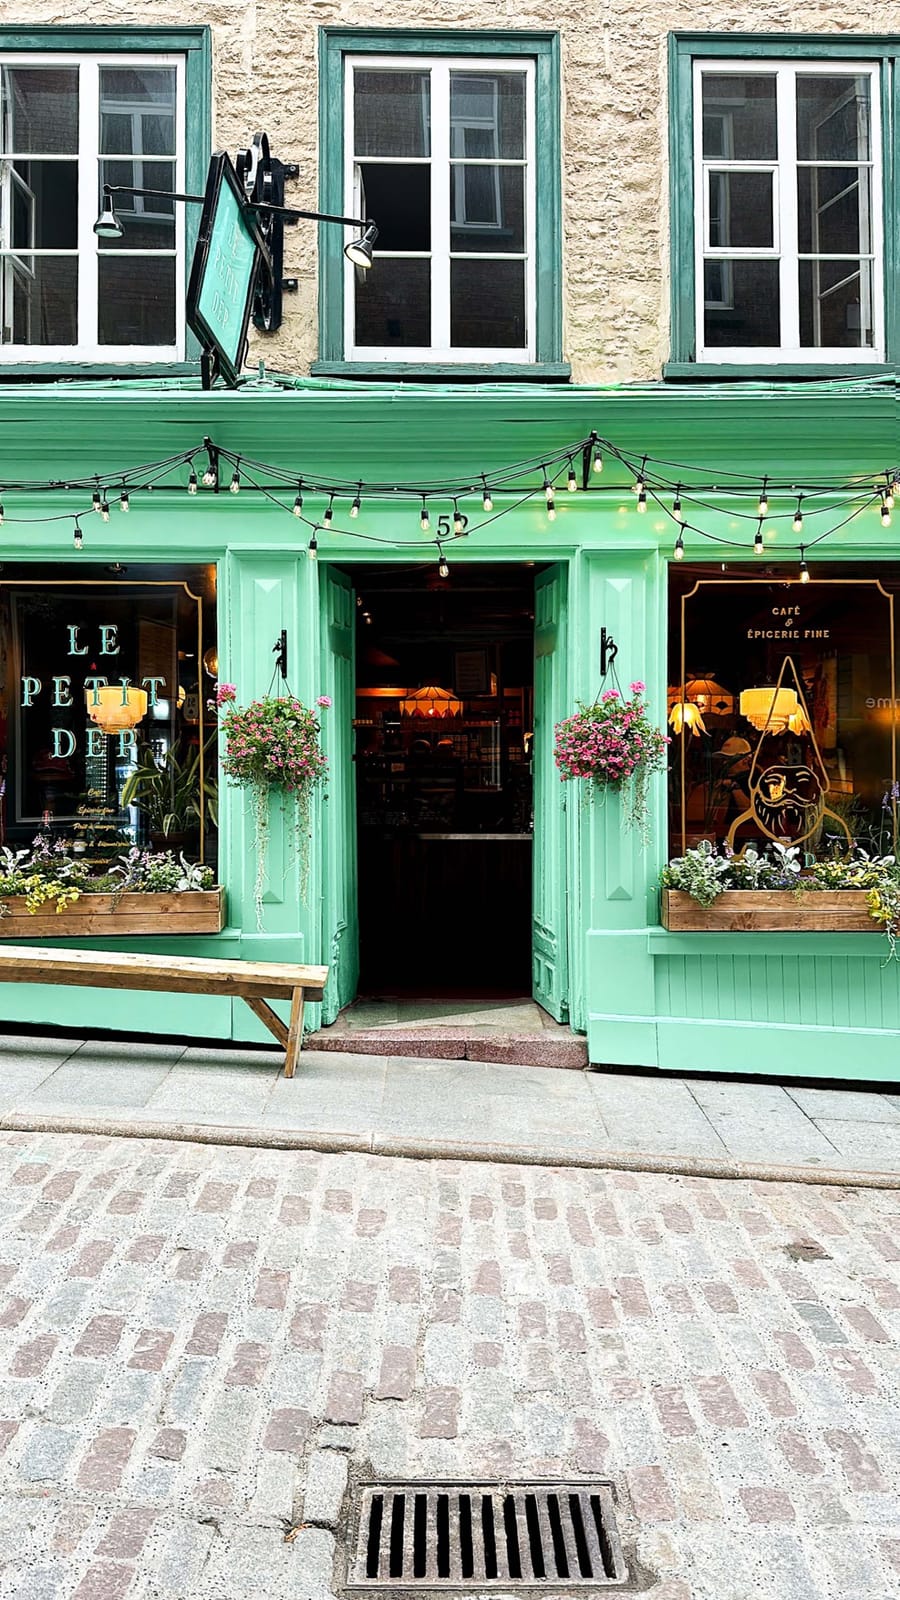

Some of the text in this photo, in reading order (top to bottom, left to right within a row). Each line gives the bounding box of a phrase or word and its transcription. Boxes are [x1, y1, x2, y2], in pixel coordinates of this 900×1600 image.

[772, 605, 800, 615] CAFÉ
[67, 624, 121, 656] LE
[747, 628, 830, 639] ÉPICERIE FINE
[20, 676, 166, 707] PETIT
[51, 727, 138, 758] DEP
